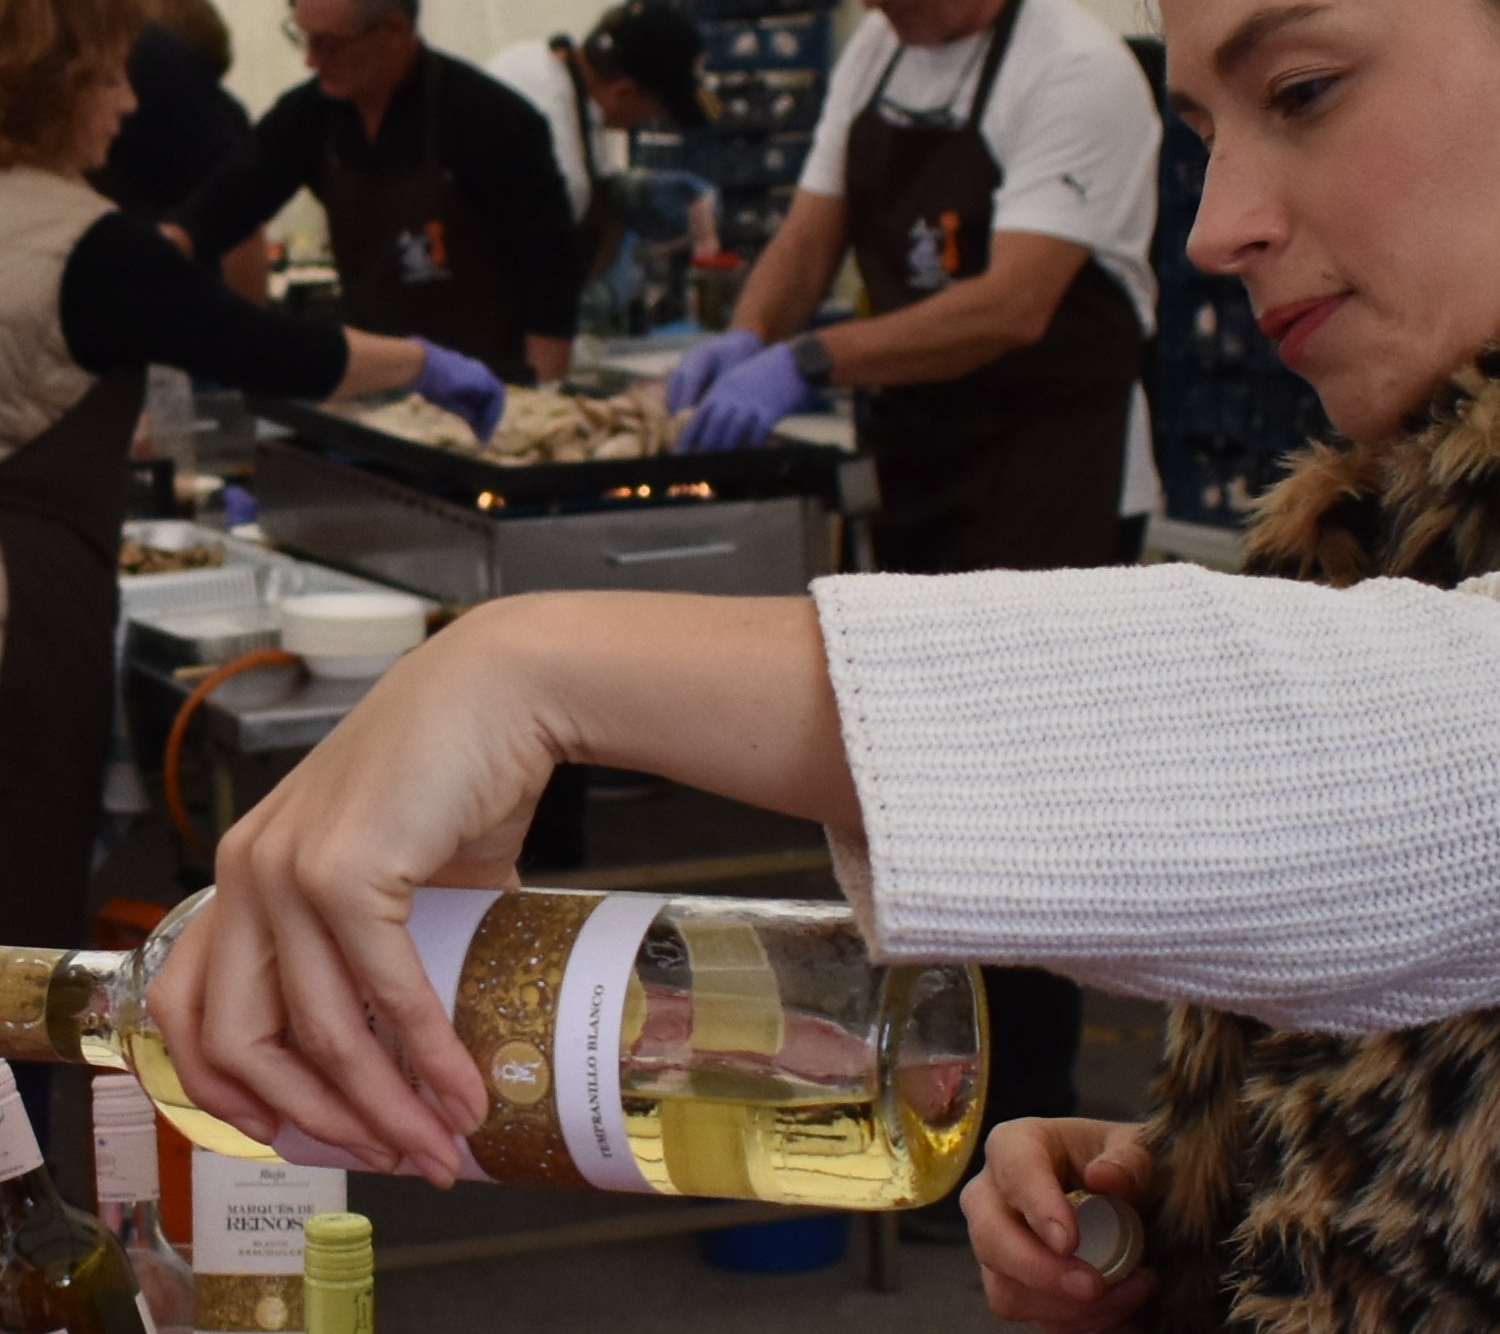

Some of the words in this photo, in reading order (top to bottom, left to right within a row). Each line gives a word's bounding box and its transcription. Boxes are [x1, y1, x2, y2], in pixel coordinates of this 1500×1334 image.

[587, 984, 605, 1051] BLANCO
[587, 1056, 613, 1159] TEMPRANILLO
[226, 1217, 305, 1231] REINOS
[298, 1204, 315, 1214] DE
